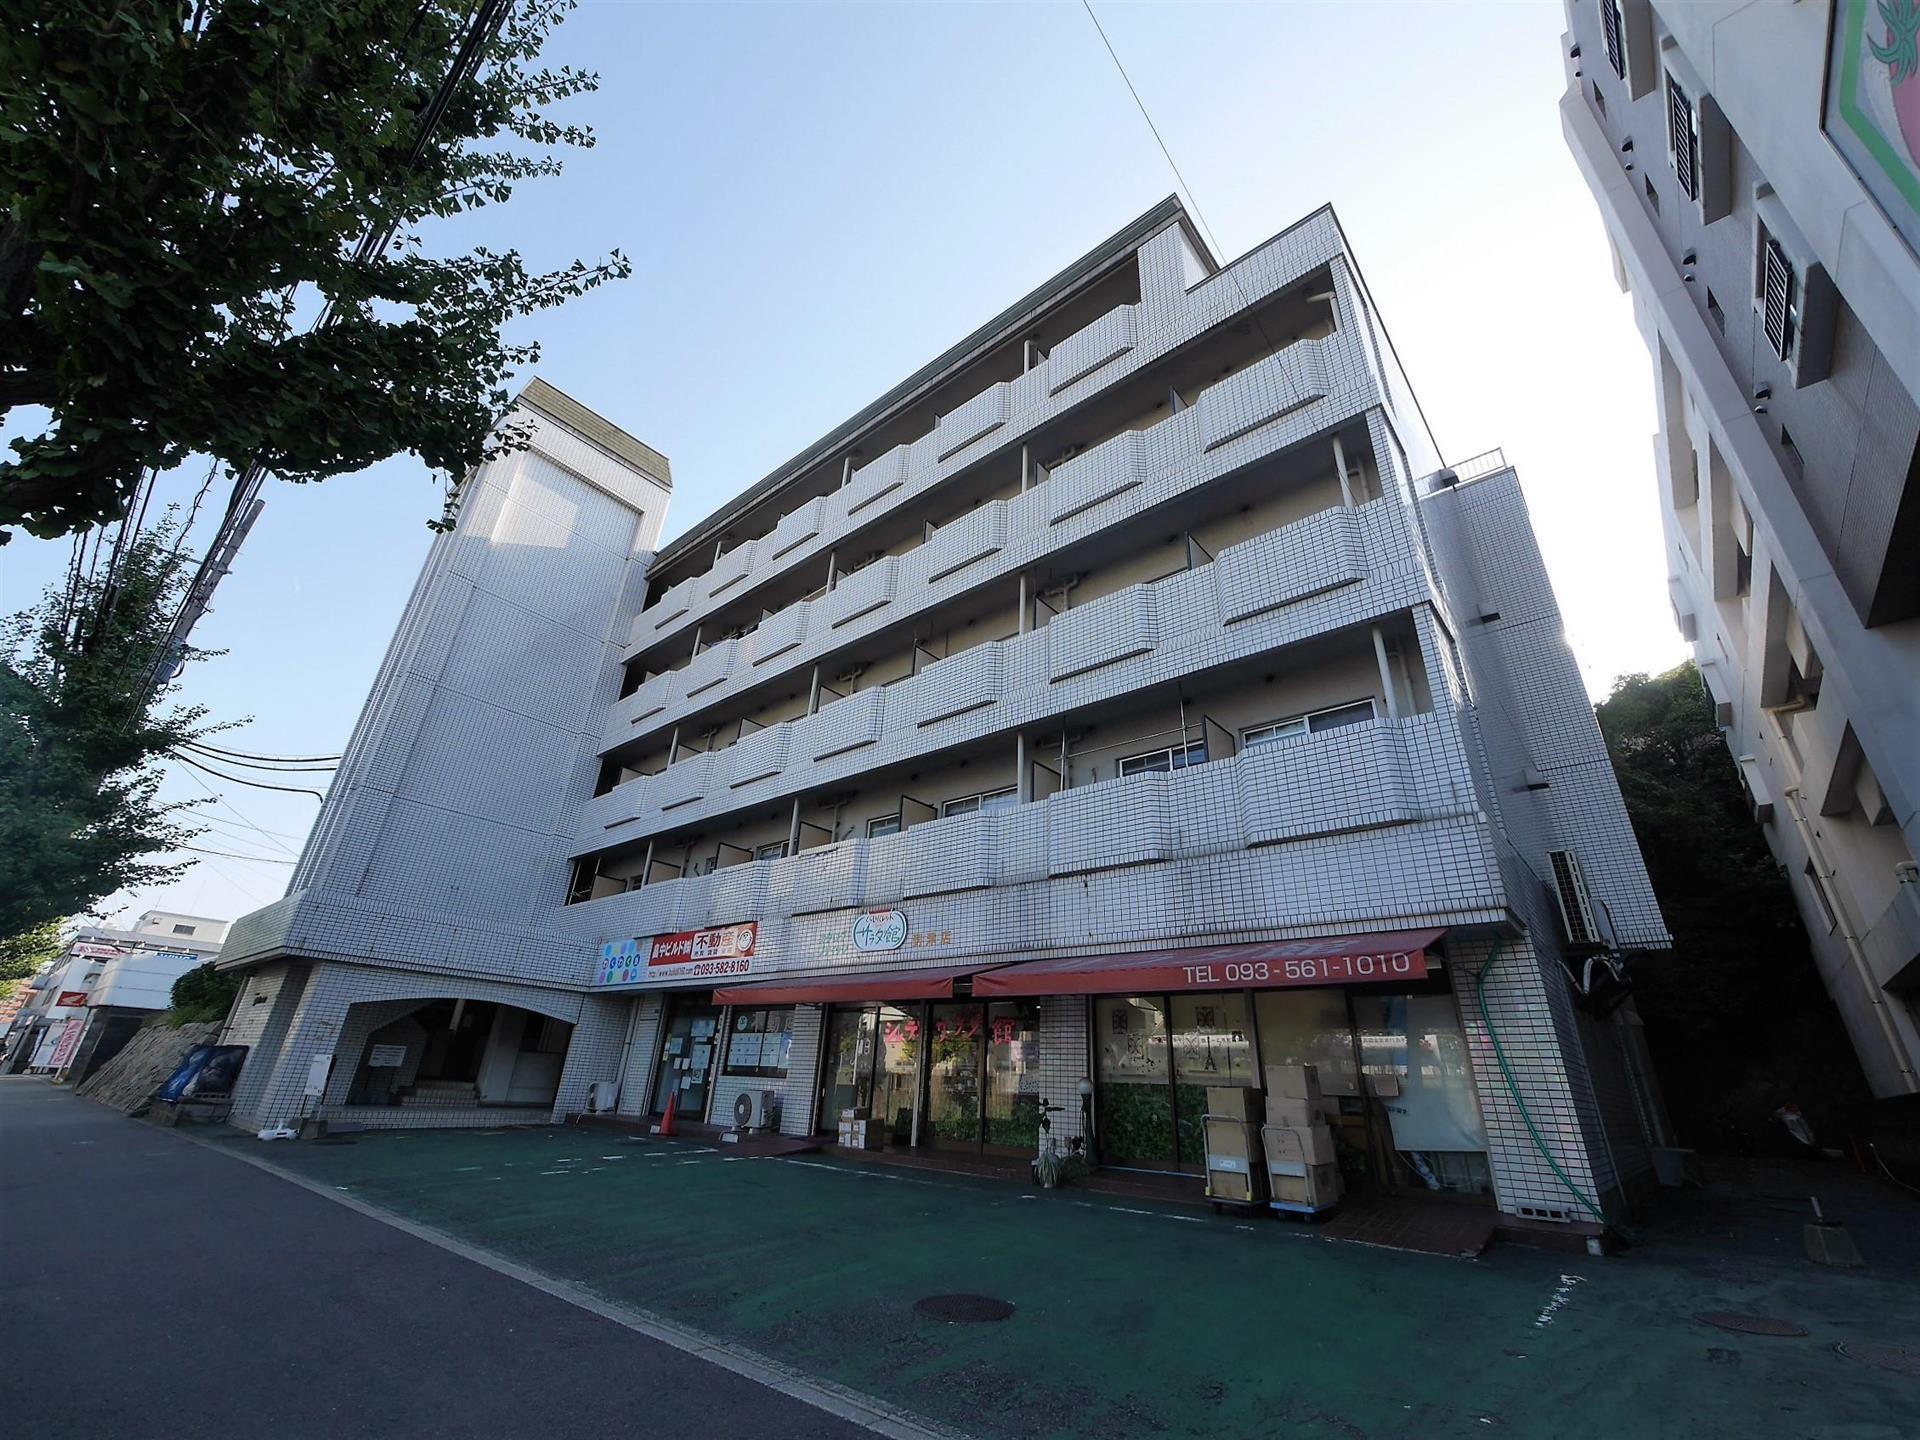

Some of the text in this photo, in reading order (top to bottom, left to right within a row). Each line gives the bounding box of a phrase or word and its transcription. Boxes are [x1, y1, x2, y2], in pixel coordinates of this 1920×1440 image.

[695, 930, 735, 949] 不動産
[701, 959, 750, 975] 093-582-8160
[1183, 966, 1220, 984] TEL
